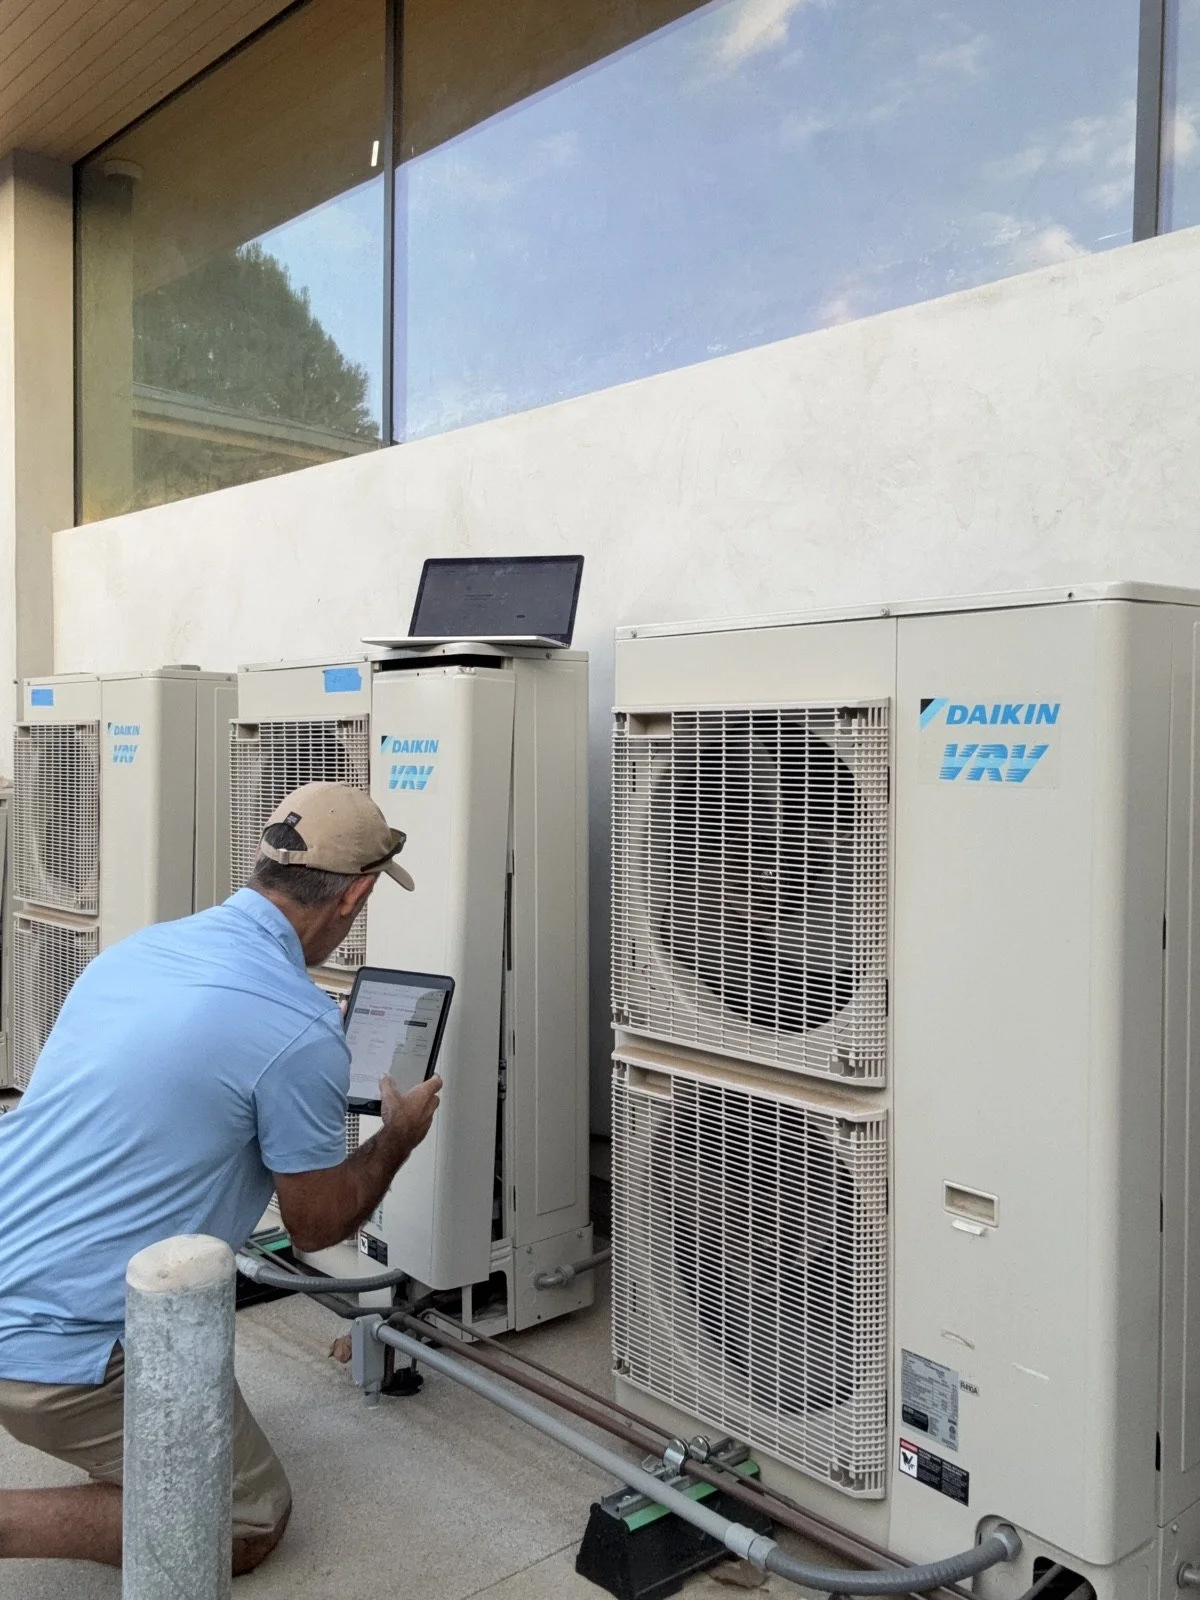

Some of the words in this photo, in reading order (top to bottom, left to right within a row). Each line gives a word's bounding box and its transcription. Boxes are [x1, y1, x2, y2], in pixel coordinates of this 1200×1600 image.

[946, 703, 1061, 725] DAIKIN
[113, 724, 141, 736] DAIKIN
[112, 744, 138, 764] VRV
[391, 739, 440, 754] DAIKIN
[938, 743, 1050, 783] VRV
[388, 764, 434, 790] VRV
